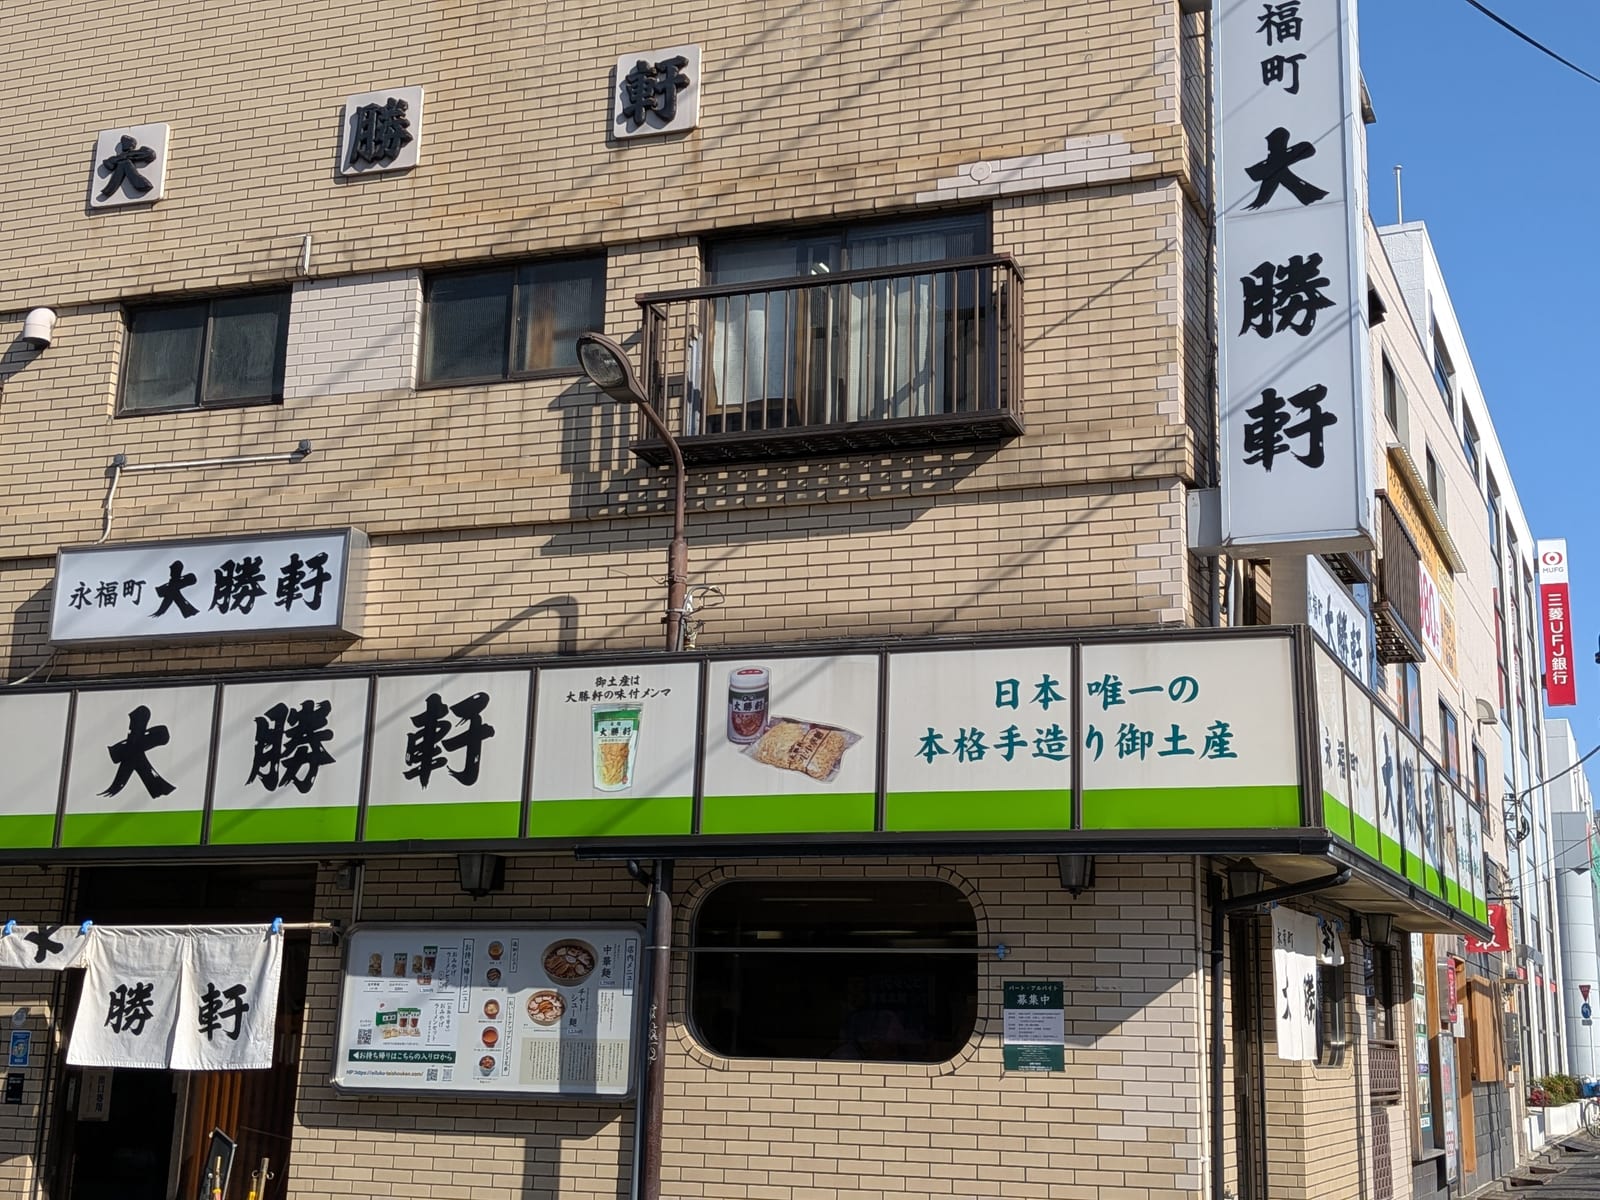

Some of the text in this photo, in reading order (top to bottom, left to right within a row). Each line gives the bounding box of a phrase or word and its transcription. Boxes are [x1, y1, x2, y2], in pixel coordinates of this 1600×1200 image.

[619, 55, 691, 127] 軒
[348, 96, 412, 168] 勝
[97, 134, 157, 200] 大
[1238, 127, 1338, 474] 大勝軒
[68, 552, 332, 619] 永福町 大勝軒
[1542, 566, 1564, 574] MUFG
[1547, 593, 1568, 686] 三菱UFJ銀行
[565, 688, 672, 703] 大勝軒の味付メンマ
[595, 674, 641, 688] 御土産は
[995, 674, 1200, 711] 日本唯一の
[97, 691, 496, 800] 大勝軒
[914, 719, 1239, 765] 本格手造り御土産
[1017, 994, 1051, 1006] 募集中
[359, 1051, 453, 1061] お持ち帰りはこちらの入り口から
